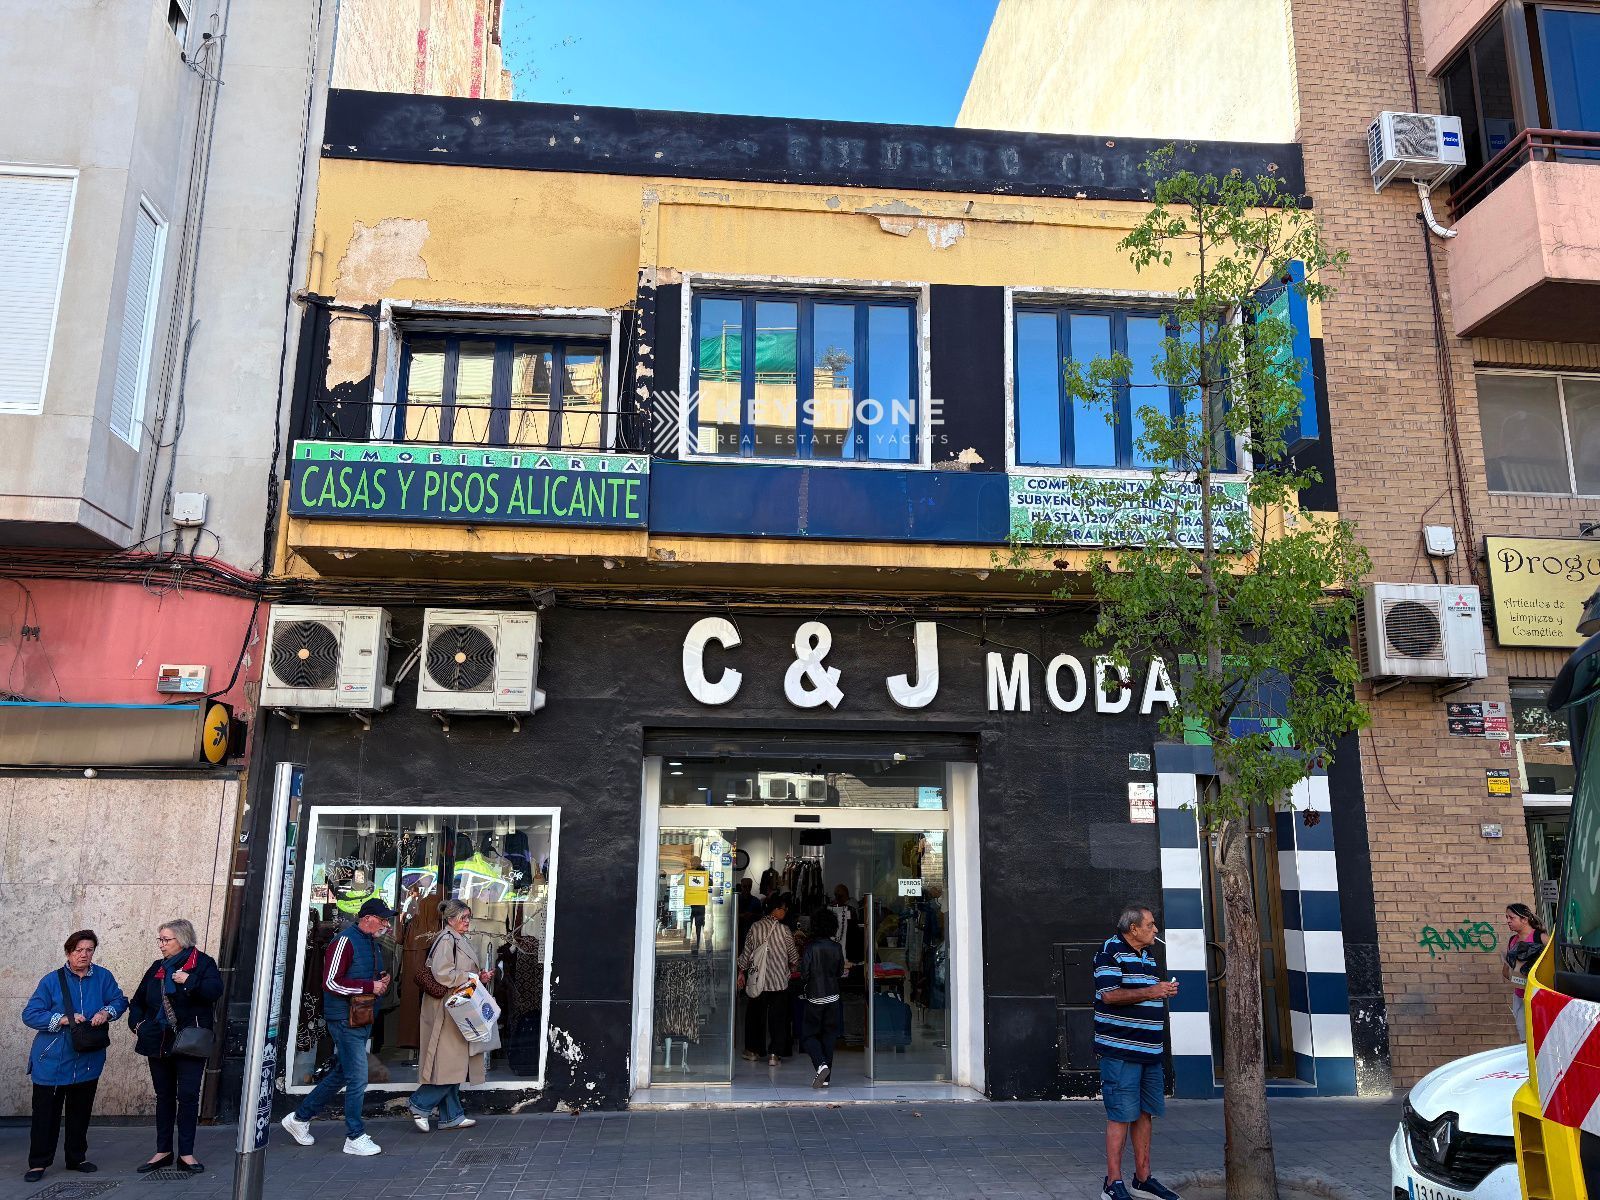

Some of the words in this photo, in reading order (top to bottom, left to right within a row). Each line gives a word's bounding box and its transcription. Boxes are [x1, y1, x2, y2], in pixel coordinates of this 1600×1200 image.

[303, 448, 641, 473] INMOBILIARIA
[300, 465, 387, 509] CASAS
[398, 470, 416, 511] Y
[423, 470, 500, 514] PISOS
[506, 474, 641, 519] ALICANTE
[1160, 483, 1224, 496] ALQUIER
[1031, 512, 1080, 523] HASTA
[1131, 513, 1153, 525] SIN
[1156, 515, 1226, 527] ETRAA
[682, 616, 743, 705] C
[783, 620, 845, 710] &
[886, 620, 940, 710] J
[986, 650, 1179, 715] MODA
